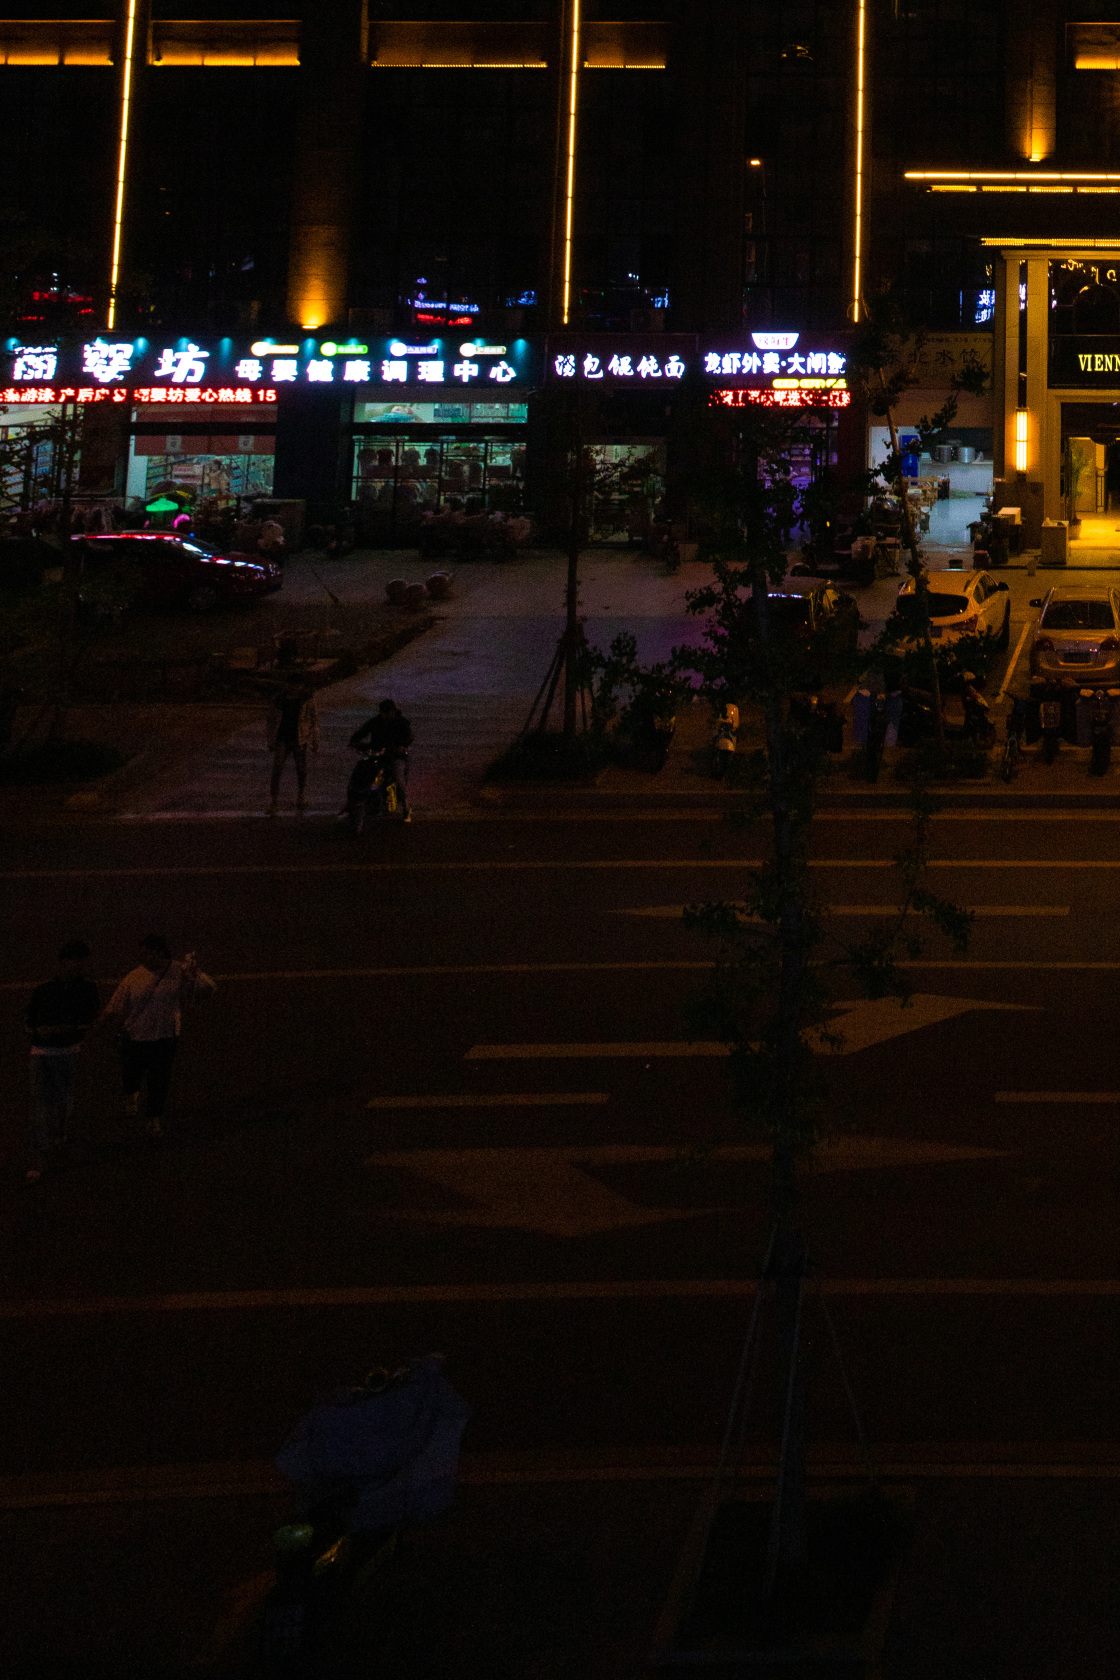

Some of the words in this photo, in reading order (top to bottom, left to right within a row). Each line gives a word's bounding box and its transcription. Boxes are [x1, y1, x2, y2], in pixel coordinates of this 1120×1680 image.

[234, 359, 517, 382] 母婴健康调理中心
